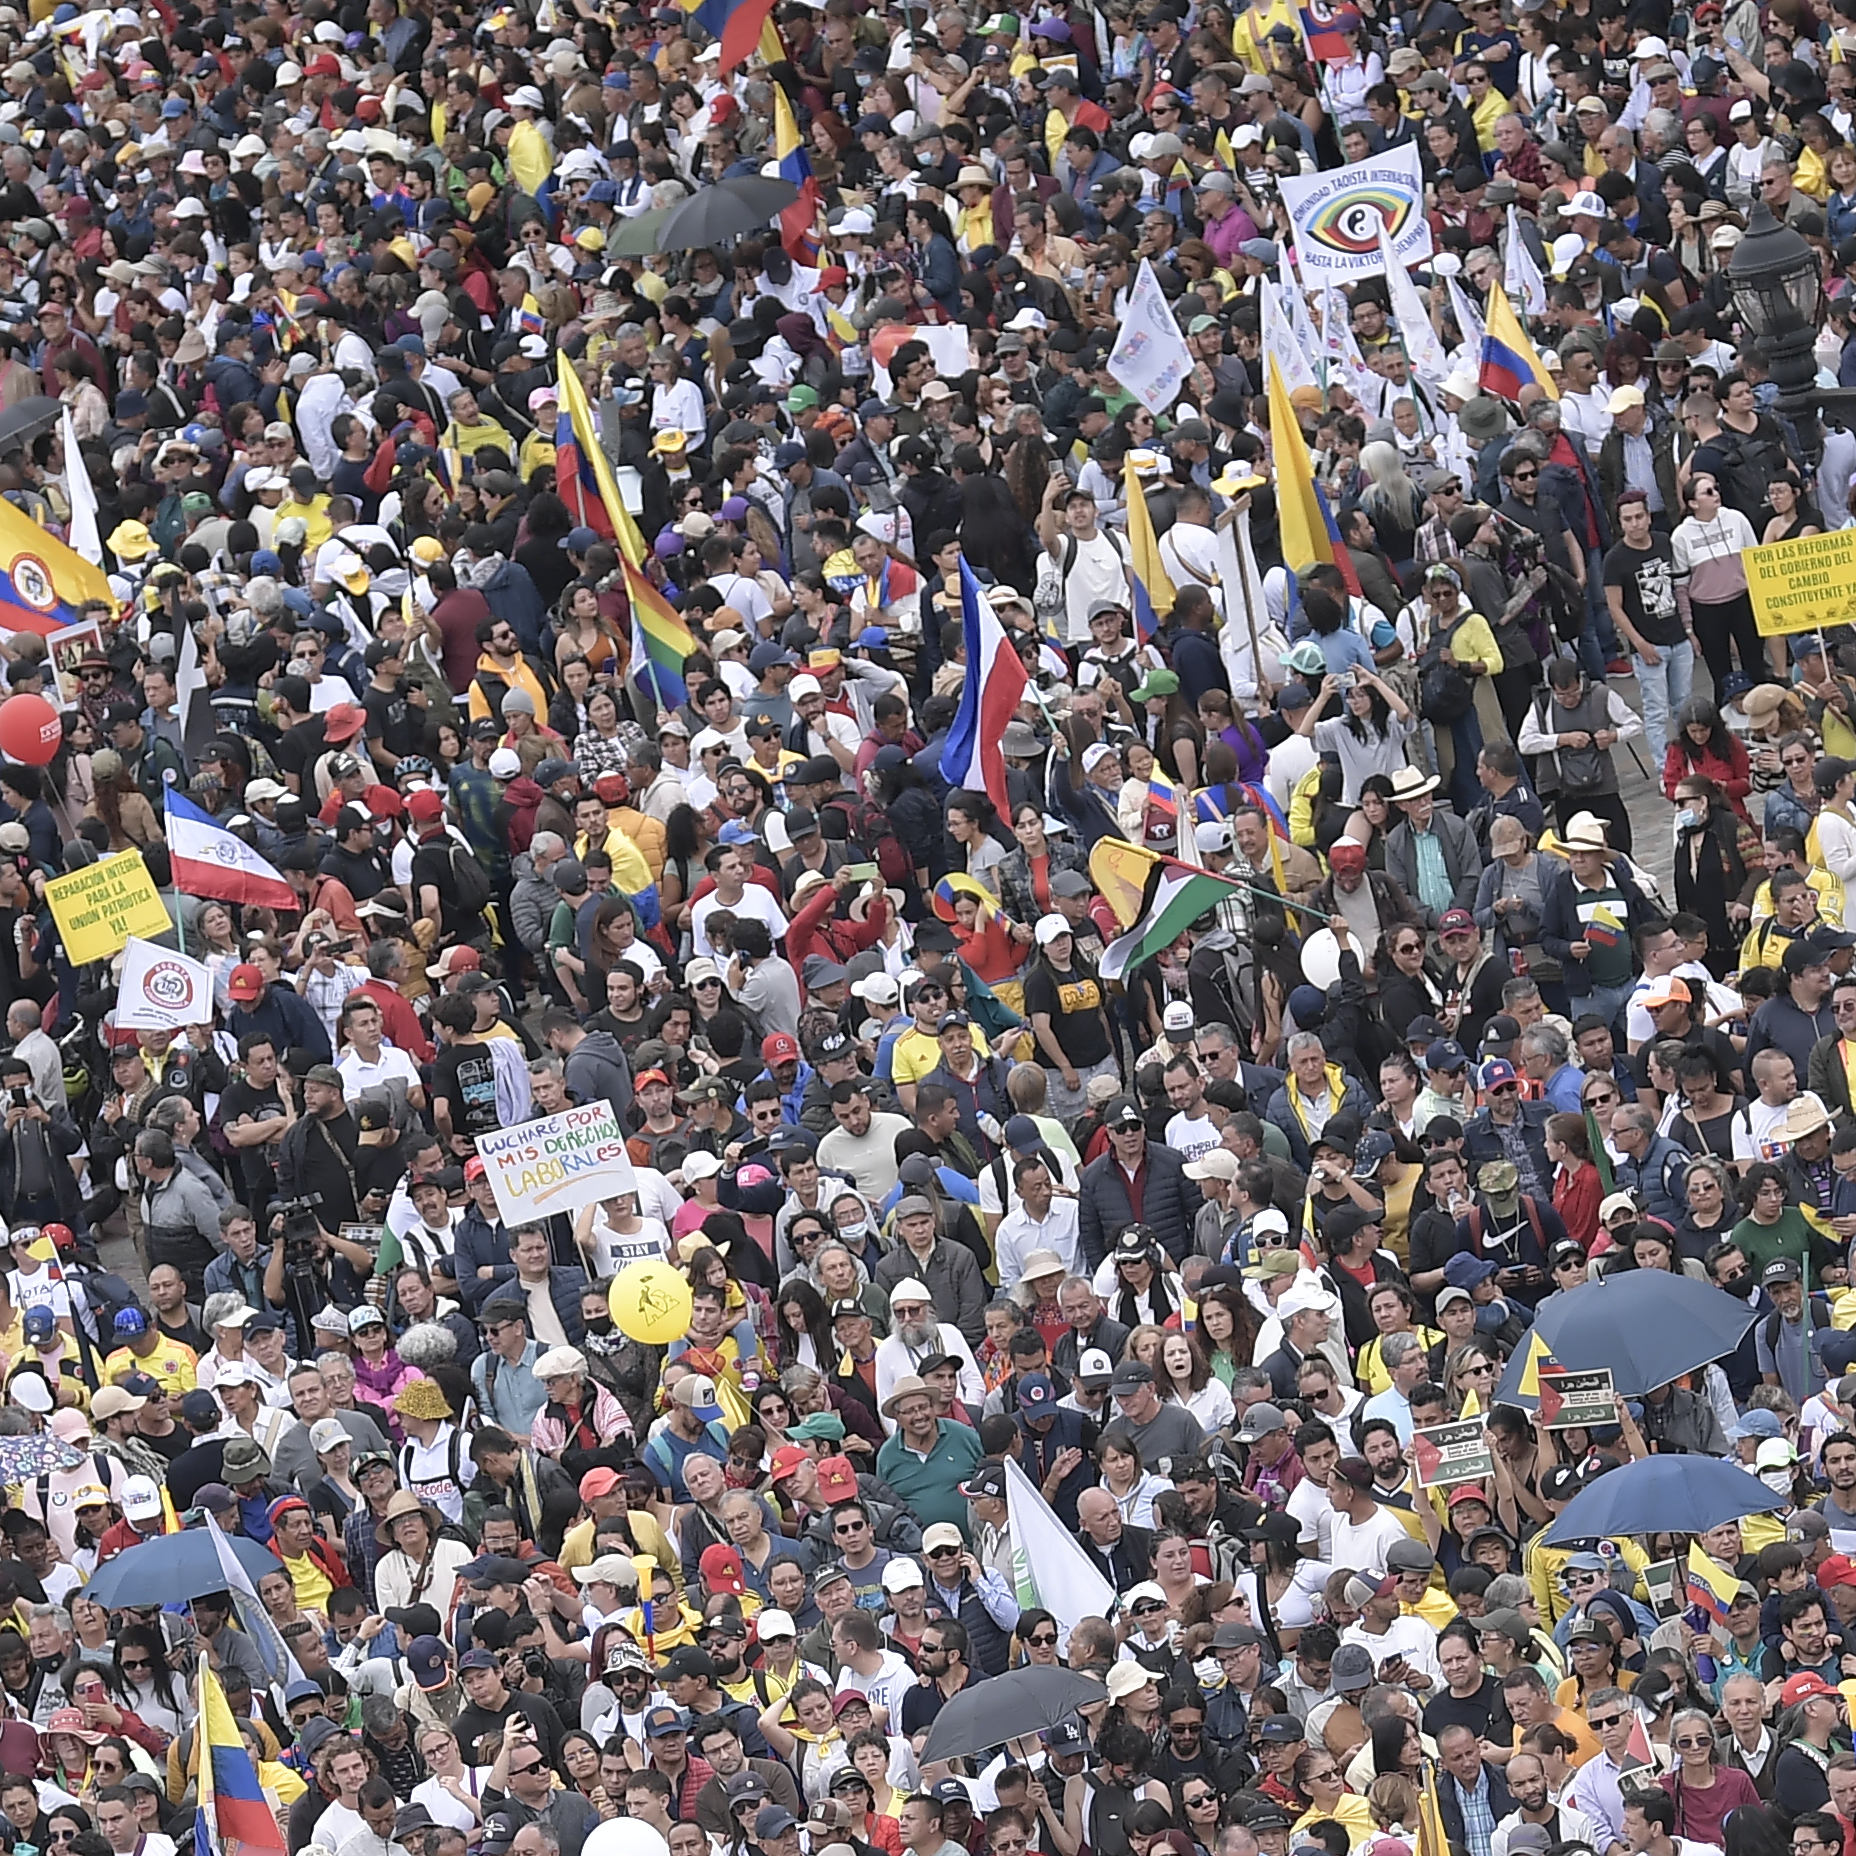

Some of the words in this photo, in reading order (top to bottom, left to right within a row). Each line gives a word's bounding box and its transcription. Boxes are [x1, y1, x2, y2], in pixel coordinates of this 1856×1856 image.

[1330, 170, 1368, 191] TAOISTA
[1305, 250, 1332, 269] HASTA
[1334, 257, 1346, 269] LA
[1753, 549, 1774, 565] POR
[1775, 546, 1794, 561] LAS
[1797, 536, 1853, 558] REFORMAS
[1759, 564, 1777, 579] DEL
[1780, 556, 1831, 576] GOBIERNO
[1834, 551, 1852, 566] DEL
[1788, 573, 1829, 588] CAMBIO
[1765, 588, 1843, 610] CONSTITUYENTE
[86, 886, 111, 906] PARA
[113, 881, 126, 896] LA
[108, 916, 128, 937] YA!
[481, 1113, 560, 1155] LUCHARÉ
[566, 1103, 607, 1128] POR
[496, 1148, 539, 1170] MIS
[543, 1118, 620, 1157] DERECHOS
[622, 1242, 649, 1256] STAY
